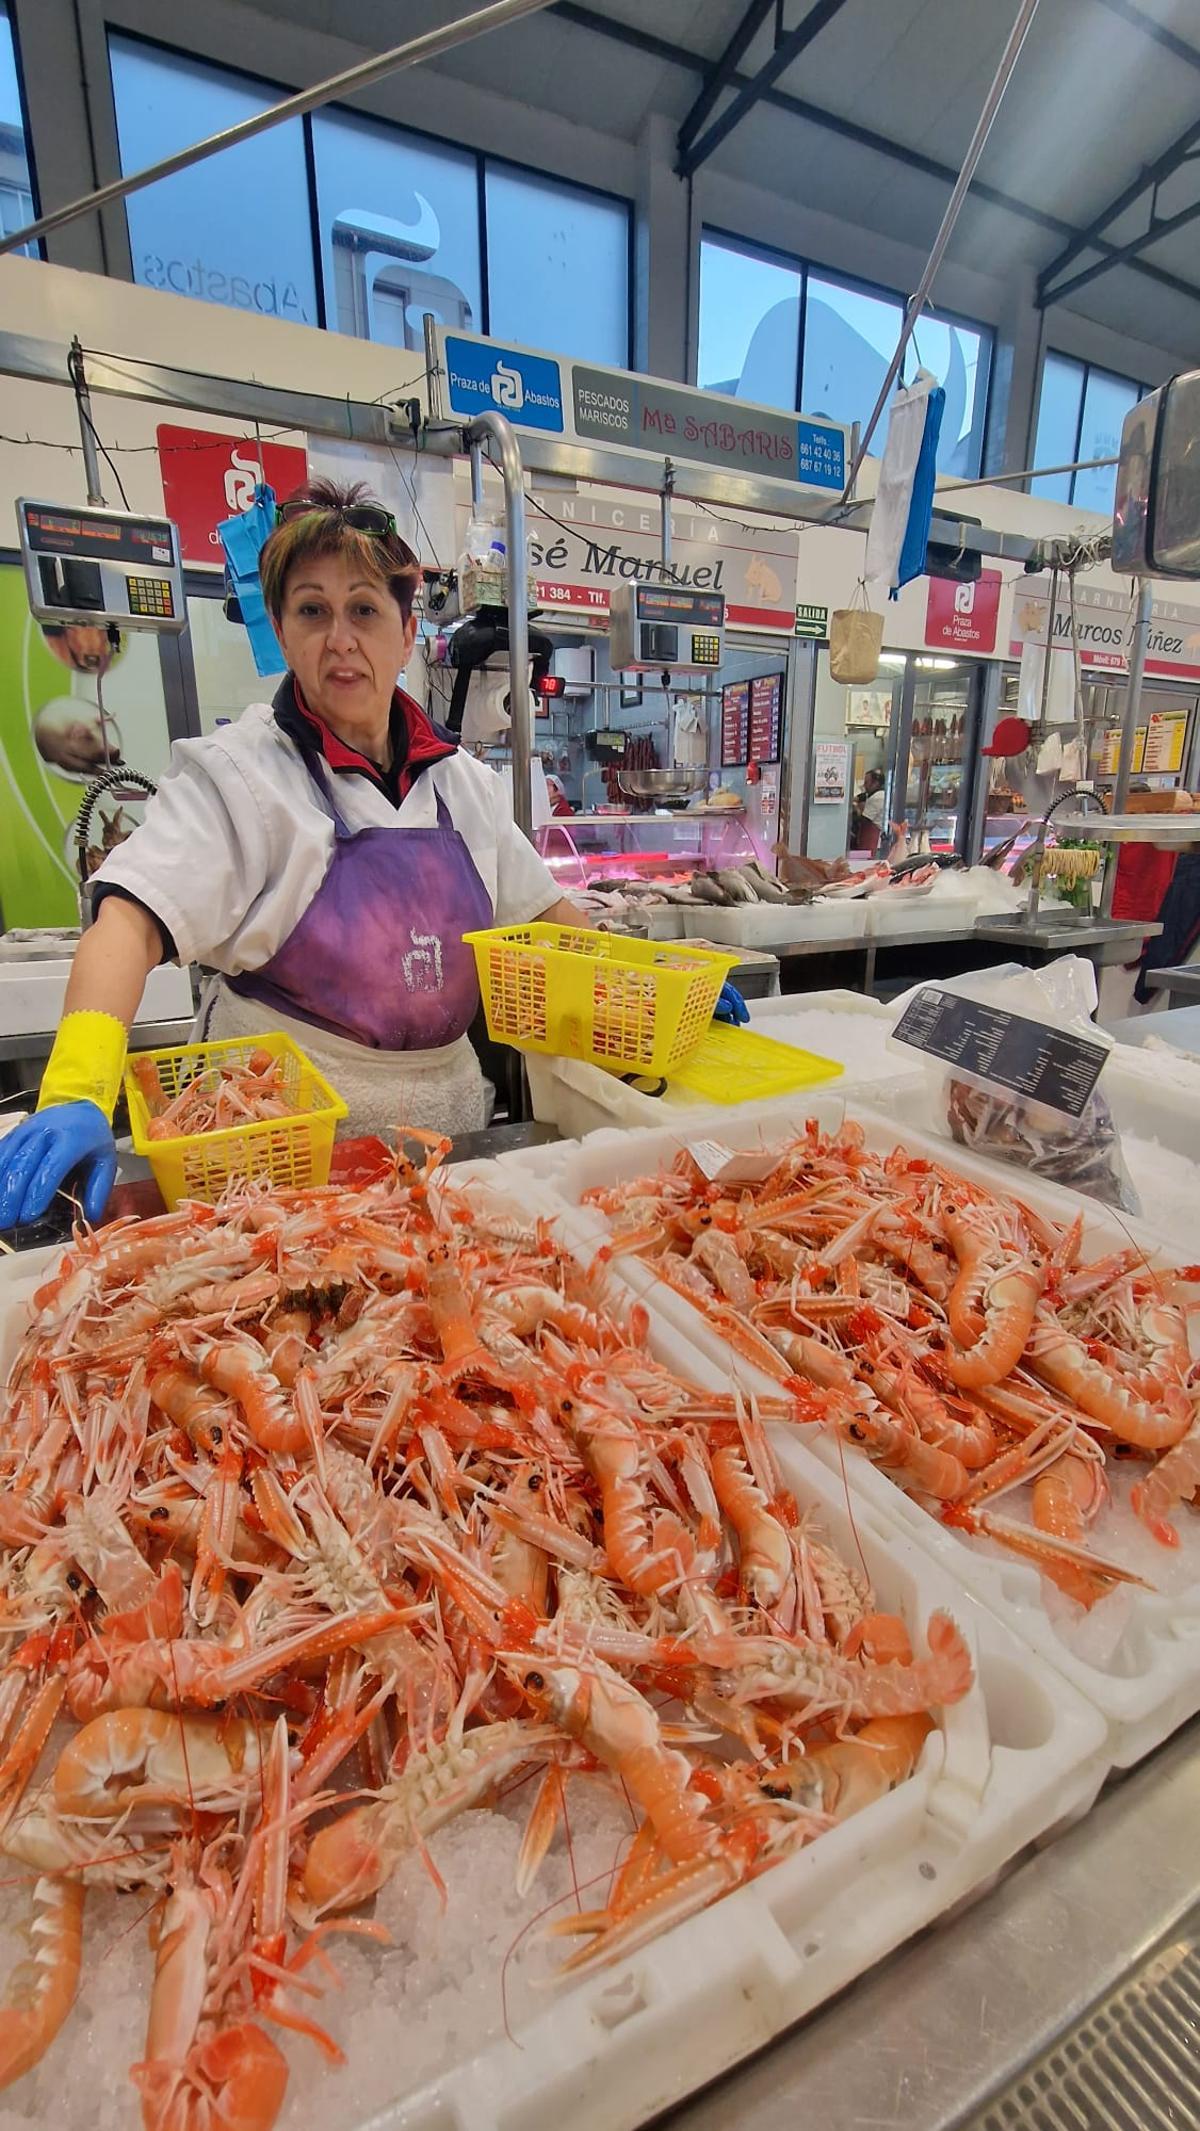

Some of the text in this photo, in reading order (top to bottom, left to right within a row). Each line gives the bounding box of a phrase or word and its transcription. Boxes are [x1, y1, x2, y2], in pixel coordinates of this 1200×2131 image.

[451, 372, 477, 390] Praza
[478, 378, 490, 394] de
[525, 389, 560, 409] Abastos
[578, 389, 630, 413] PESCADOS
[579, 406, 629, 430] MARISCOS
[683, 415, 793, 461] SABARIS
[580, 542, 724, 590] Manuel
[549, 587, 571, 601] 384
[798, 606, 826, 620] SALIDA
[953, 614, 972, 627] Praza
[942, 625, 980, 640] de Abastos
